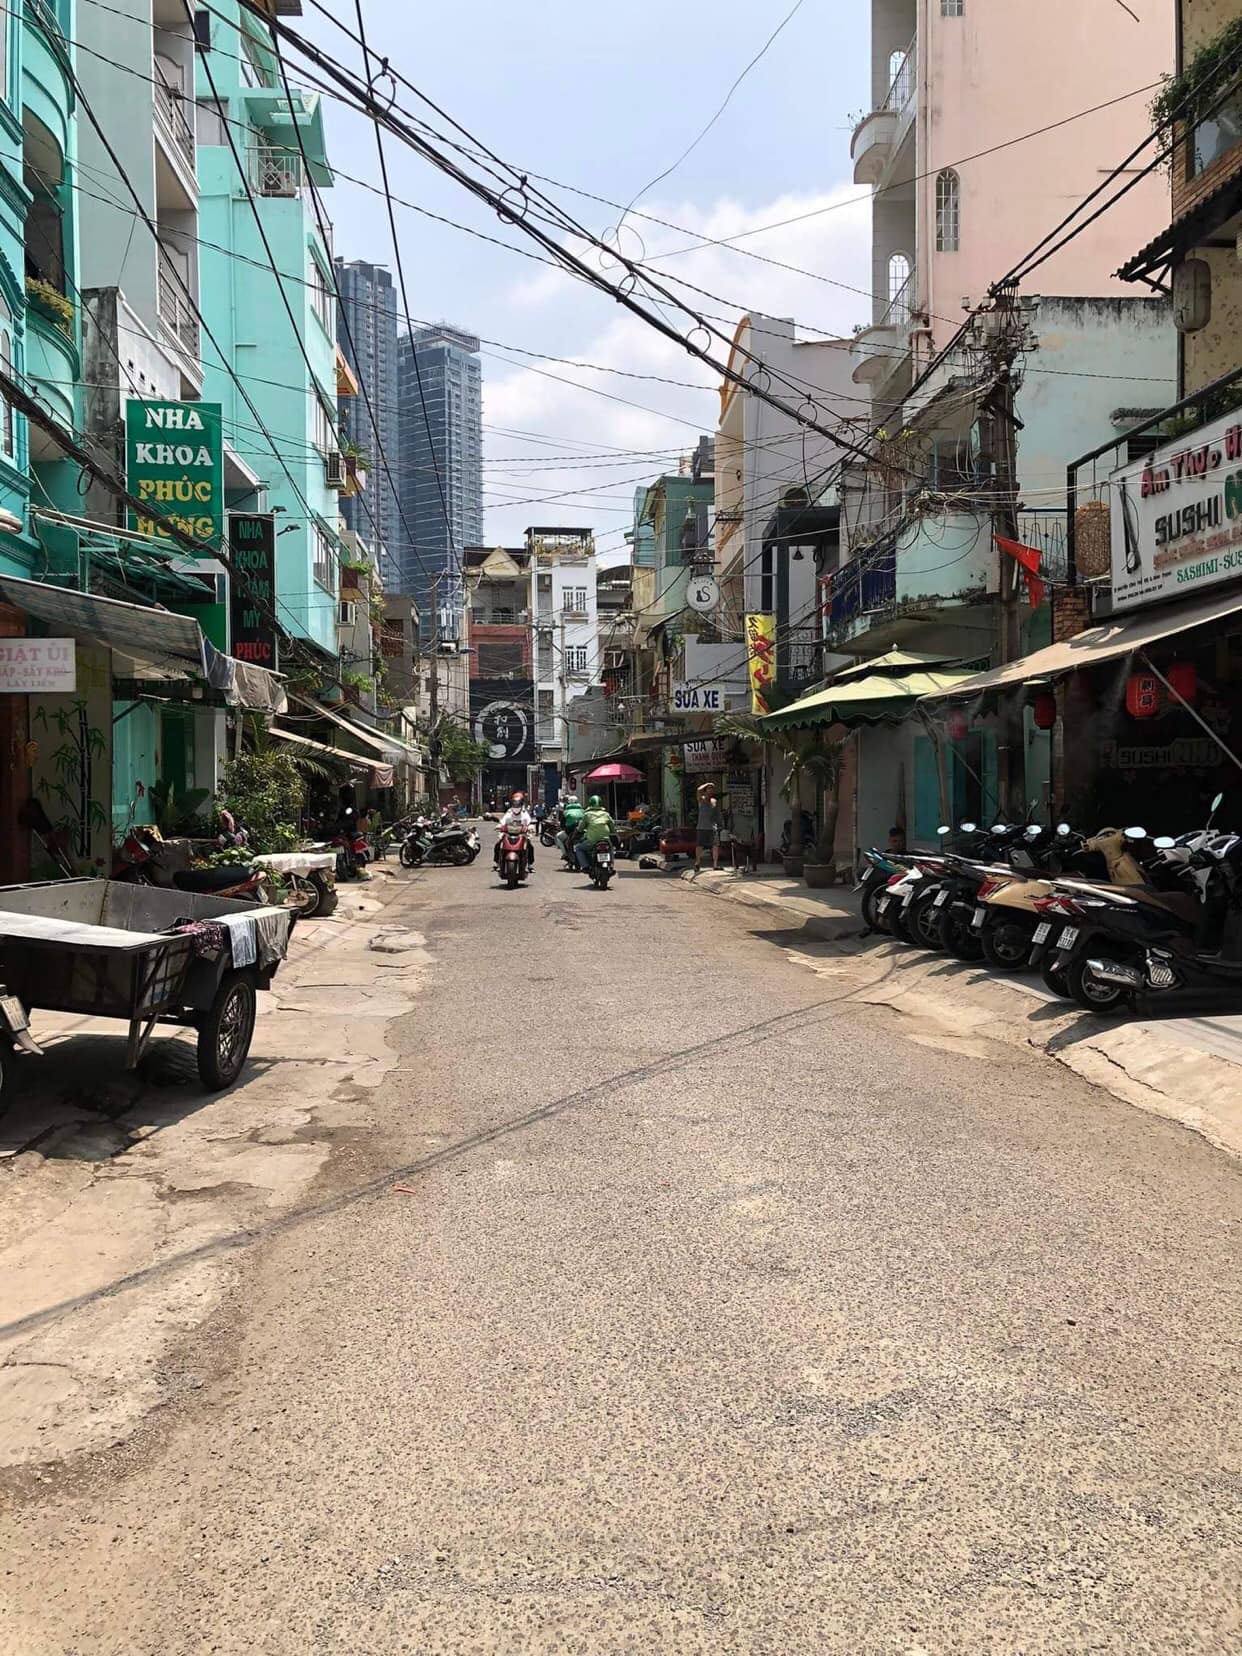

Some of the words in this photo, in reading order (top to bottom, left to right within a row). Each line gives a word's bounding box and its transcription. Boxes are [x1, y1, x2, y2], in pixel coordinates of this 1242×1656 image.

[145, 407, 204, 430] NHA
[135, 442, 214, 466] KHOA
[138, 475, 212, 503] PHÚC
[238, 520, 264, 540] NHA
[1155, 494, 1219, 546] SUSHI
[234, 550, 269, 569] KHOA
[235, 636, 271, 661] PHÚC
[704, 690, 719, 708] XE
[712, 736, 725, 751] XE
[1120, 750, 1169, 764] SUSHI
